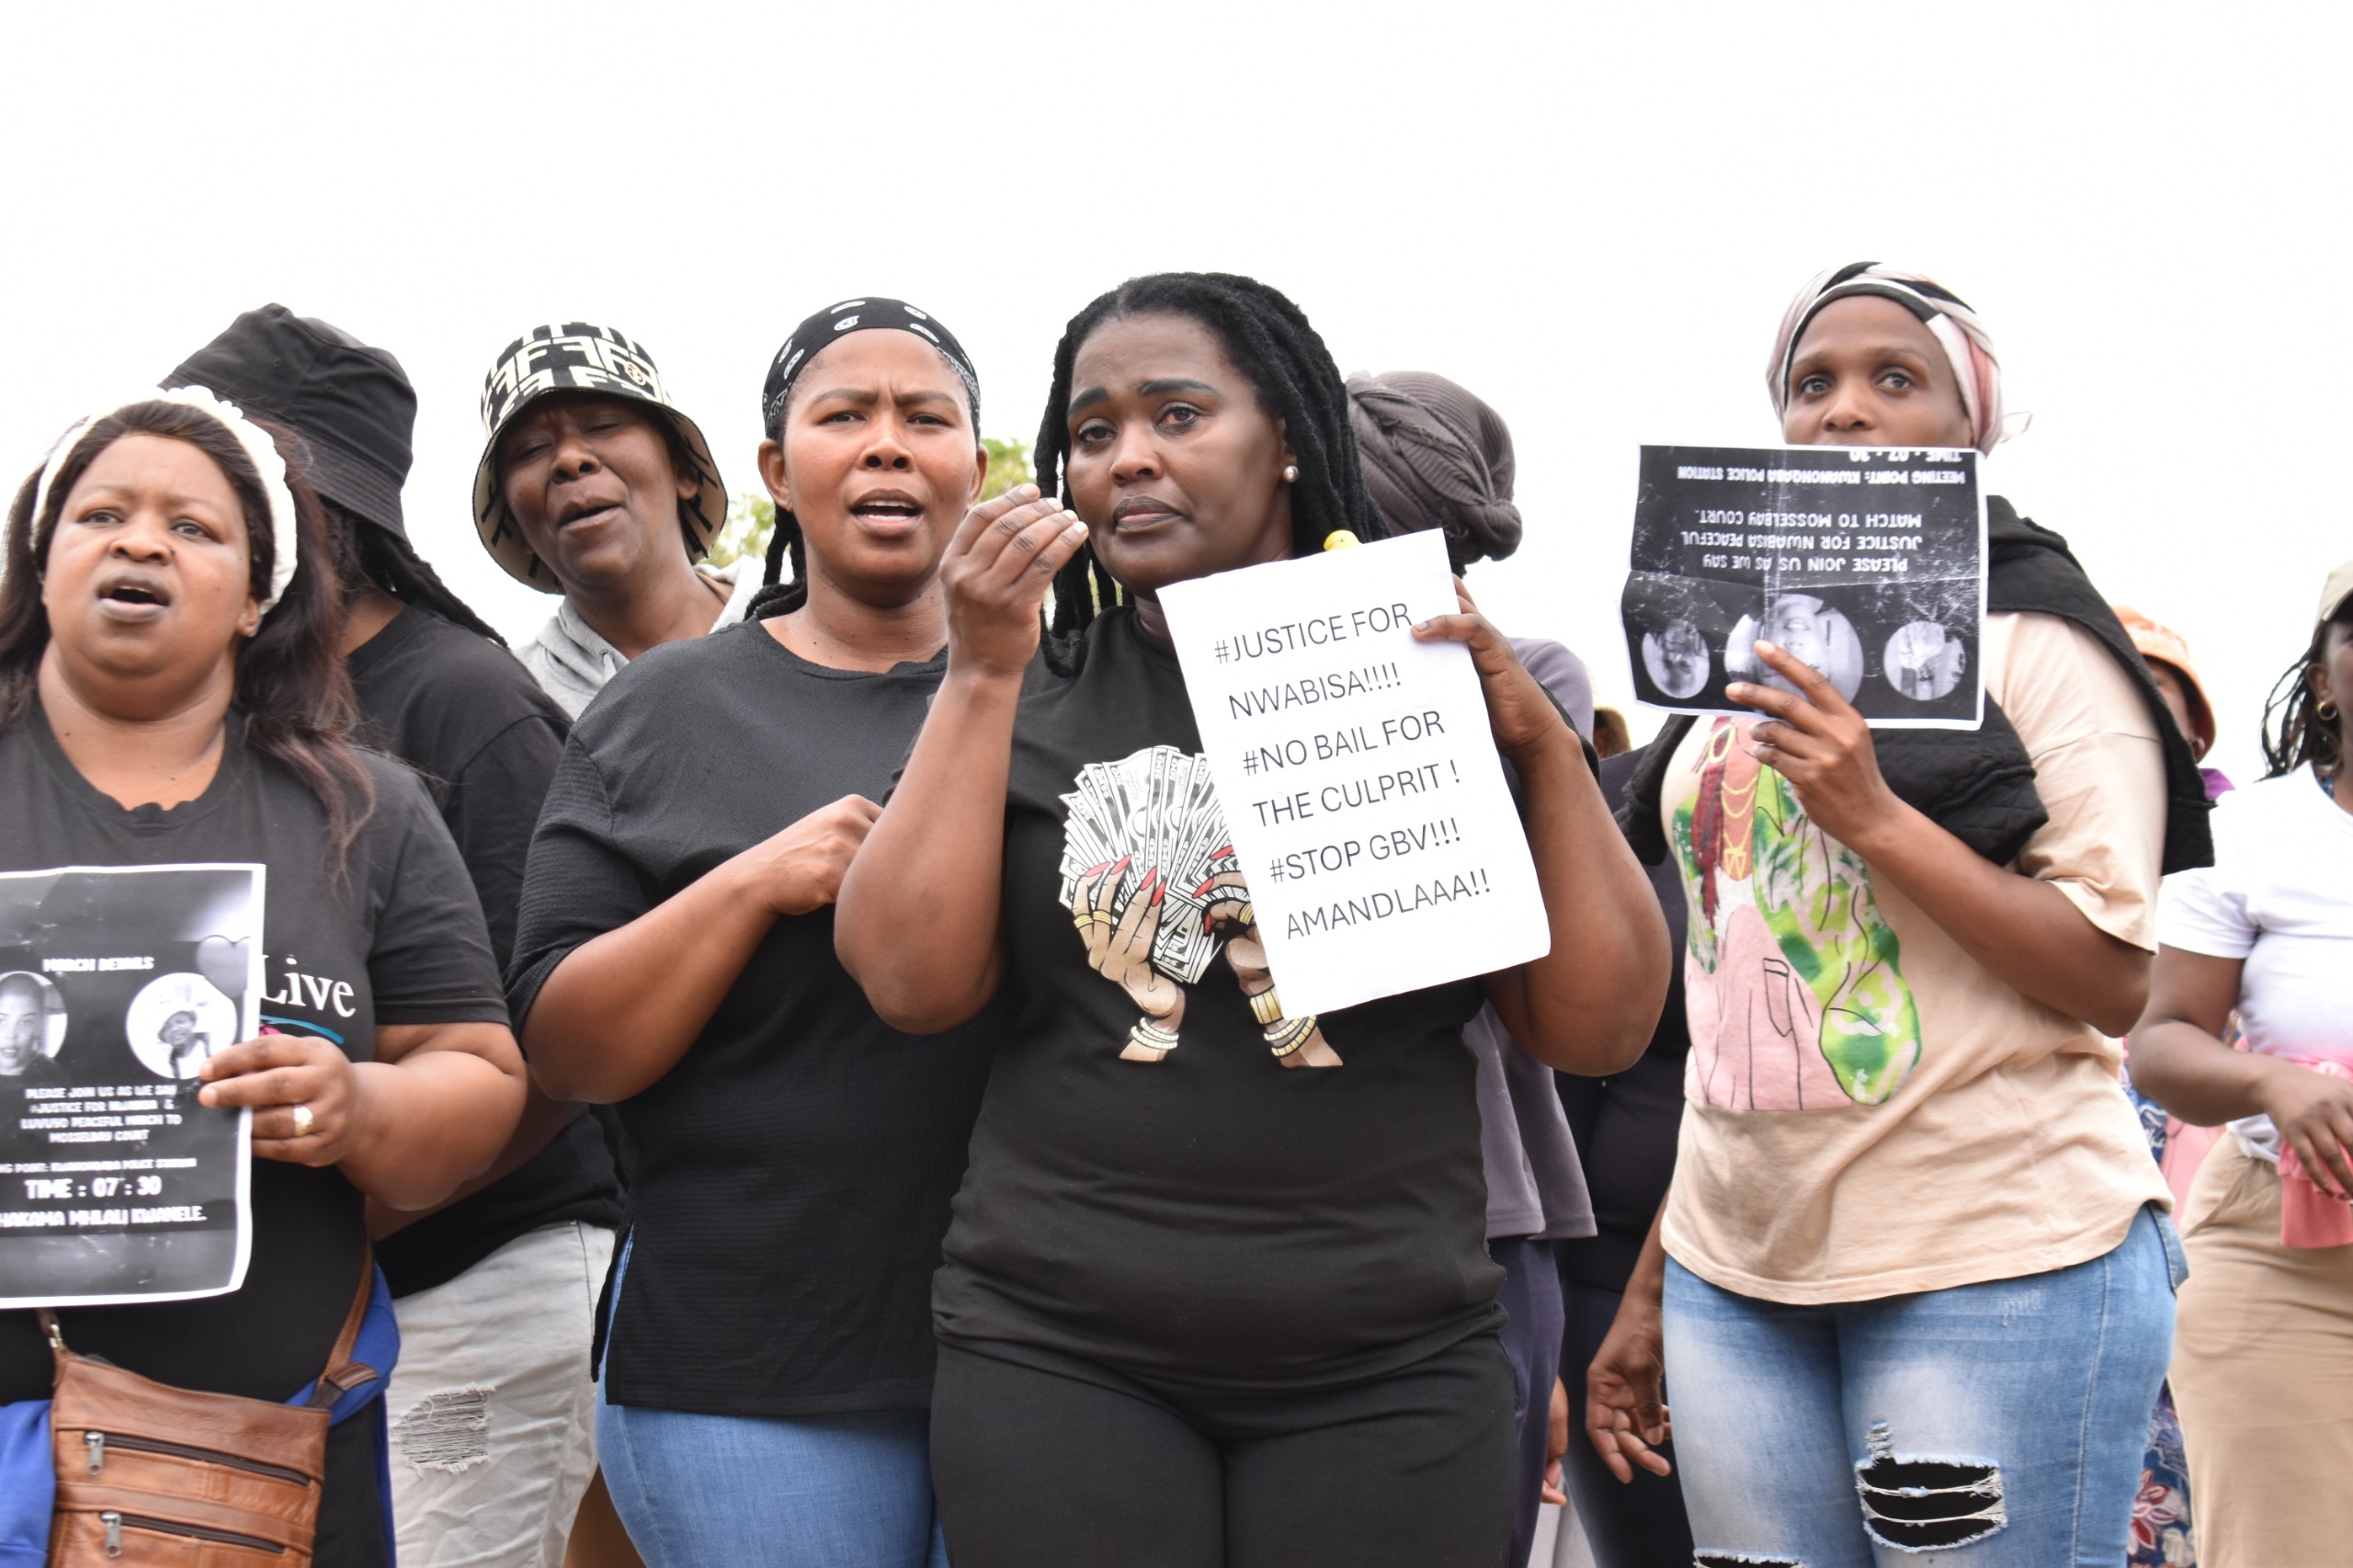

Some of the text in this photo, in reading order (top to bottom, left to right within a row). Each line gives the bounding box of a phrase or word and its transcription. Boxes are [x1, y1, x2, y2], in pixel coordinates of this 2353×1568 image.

[1677, 466, 1723, 480] STATION
[1726, 467, 1765, 482] POLICE
[1864, 470, 1908, 483] POINT:
[1912, 471, 1966, 483] MEETING
[1695, 509, 1922, 528] MATCH TO MOSSELBAY COURT.
[1680, 531, 1923, 550] JUSTICE FOR NWABISA PEACEFUL
[1702, 553, 1908, 572] PLEASE JOIN US AS WE SAY
[1214, 602, 1413, 665] #JUSTICE FOR
[1229, 662, 1403, 720] NWABISA!!!!
[1243, 710, 1446, 776] #NO BAIL FOR
[1253, 792, 1315, 827] THE
[1321, 763, 1441, 813] CULPRIT
[1269, 817, 1462, 883] #STOP GBV!!!
[1287, 868, 1492, 939] AMANDLAAA!!
[24, 1088, 66, 1099] PLEASE
[68, 1086, 96, 1097] JOIN
[97, 1086, 114, 1097] US
[117, 1086, 132, 1096] AS
[85, 1101, 107, 1112] FOR
[71, 1116, 123, 1128] PEACEFUL
[165, 1114, 182, 1125] TO
[24, 1178, 74, 1199] TIME
[92, 1176, 119, 1197] 07
[137, 1176, 162, 1196] 30
